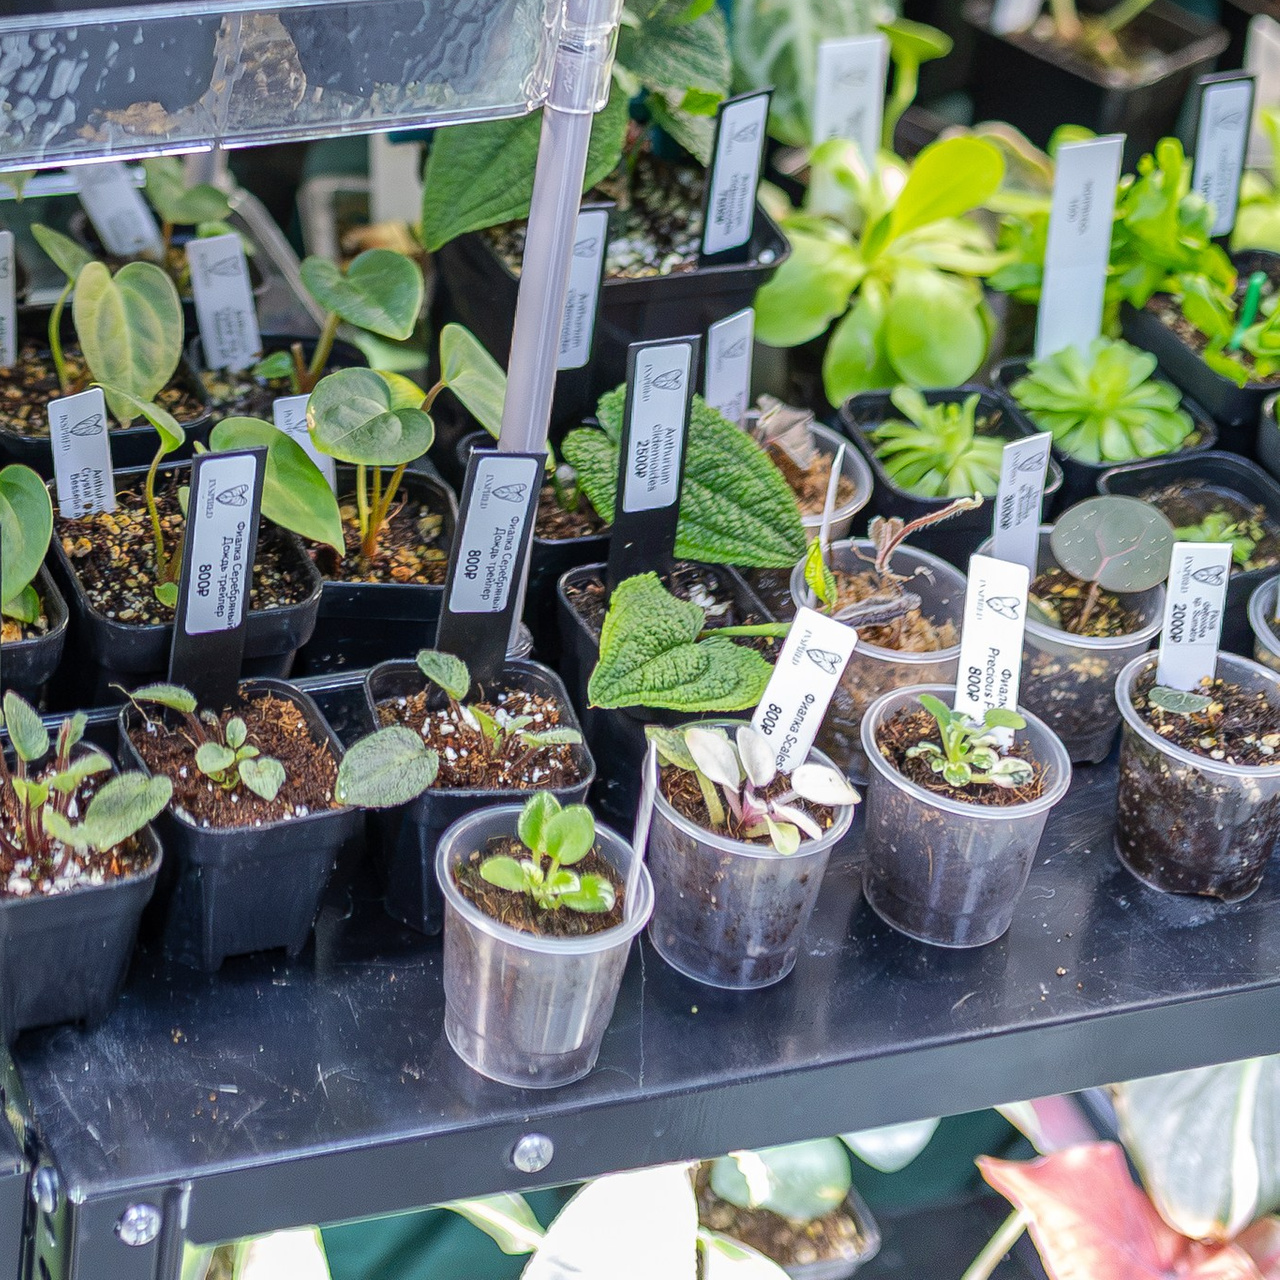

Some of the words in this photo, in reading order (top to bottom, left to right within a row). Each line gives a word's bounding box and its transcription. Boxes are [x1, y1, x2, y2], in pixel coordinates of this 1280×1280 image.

[633, 439, 651, 480] 2500₽
[660, 427, 678, 486] Anthurium
[232, 521, 246, 561] Фиалка
[489, 527, 507, 559] Дождь
[503, 516, 520, 551] Фиалка
[219, 536, 234, 572] Дождь
[463, 549, 482, 581] 800₽
[196, 563, 212, 597] 800₽
[213, 573, 231, 618] трейлер
[480, 561, 499, 601] трейлер
[1168, 603, 1188, 644] 2000₽
[966, 666, 983, 702] 800₽
[983, 647, 1001, 698] Precious
[997, 668, 1012, 709] Фиалк
[760, 703, 783, 736] 800₽
[789, 693, 816, 733] Фиалка
[775, 734, 798, 768] Scales
